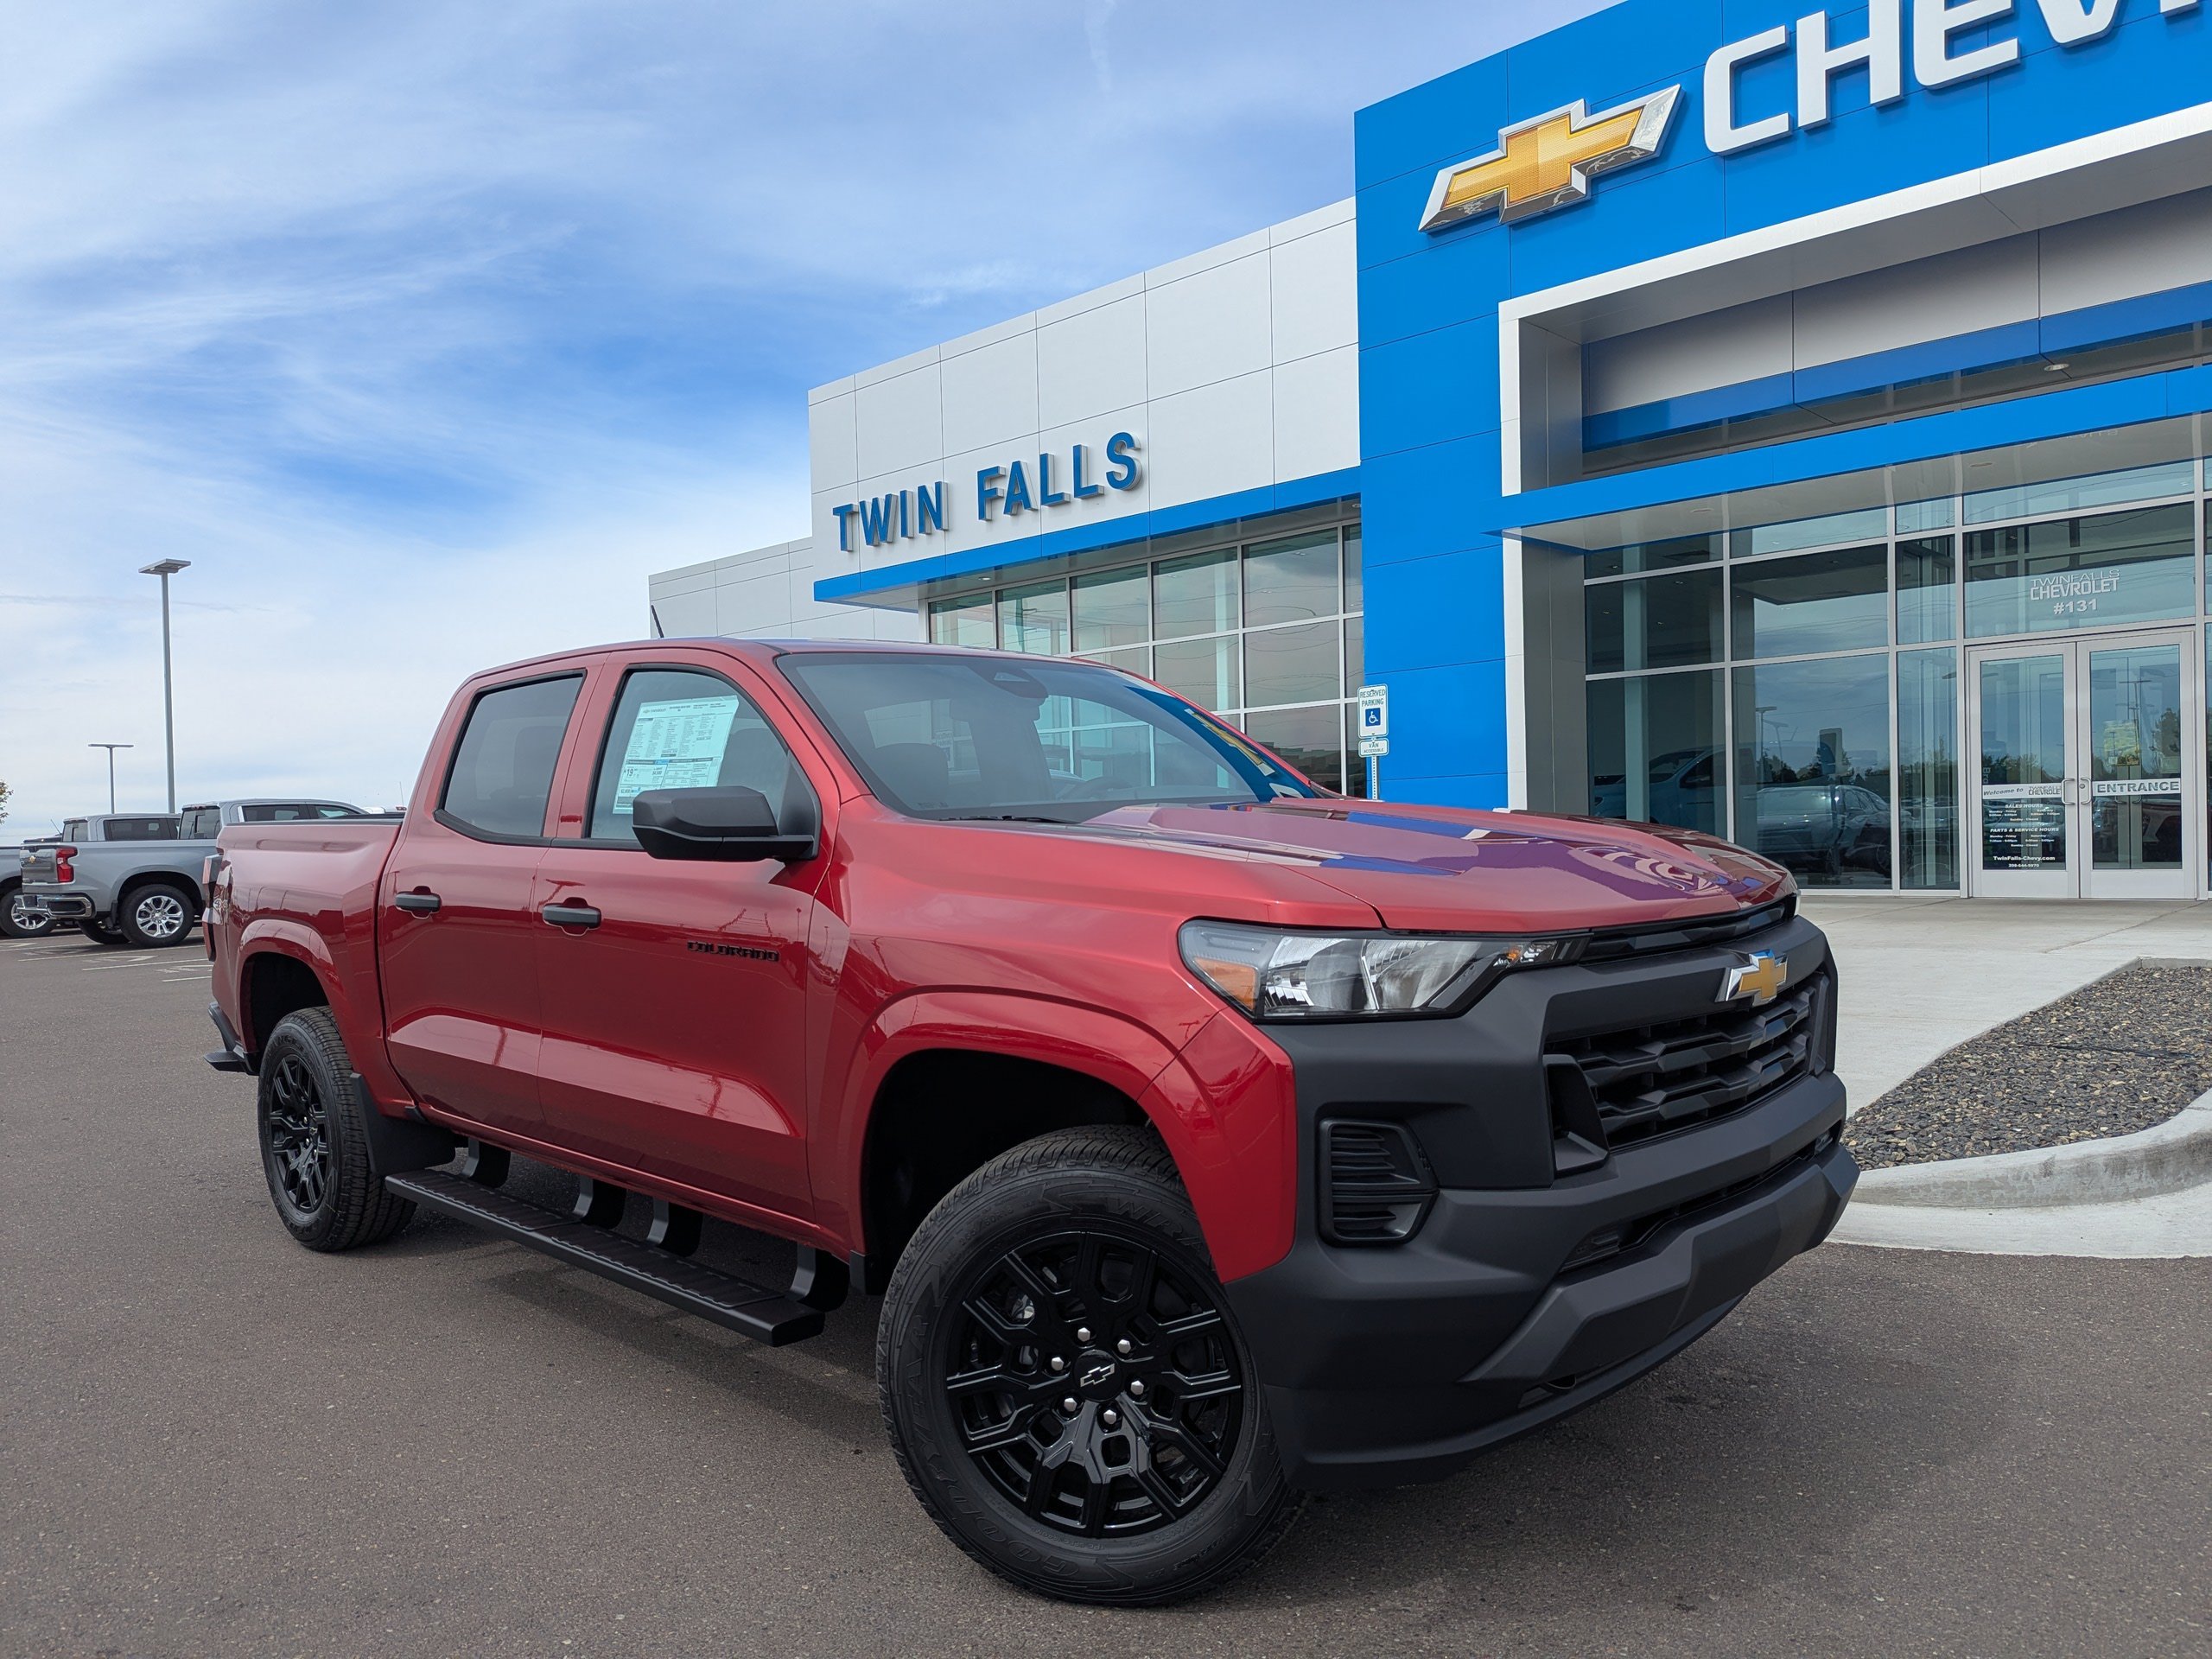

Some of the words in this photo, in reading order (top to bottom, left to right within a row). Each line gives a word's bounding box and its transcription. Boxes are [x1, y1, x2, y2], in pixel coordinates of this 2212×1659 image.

[1703, 0, 2200, 155] CHE
[833, 480, 949, 552] TWIN
[976, 432, 1142, 522] FALLS
[2030, 577, 2120, 601] CHEVROLET
[2053, 598, 2098, 615] #131
[1359, 689, 1386, 699] RESERVED
[1361, 698, 1384, 708] PARKING
[1983, 787, 2015, 796] Welcome
[2097, 780, 2180, 793] ENTRANCE
